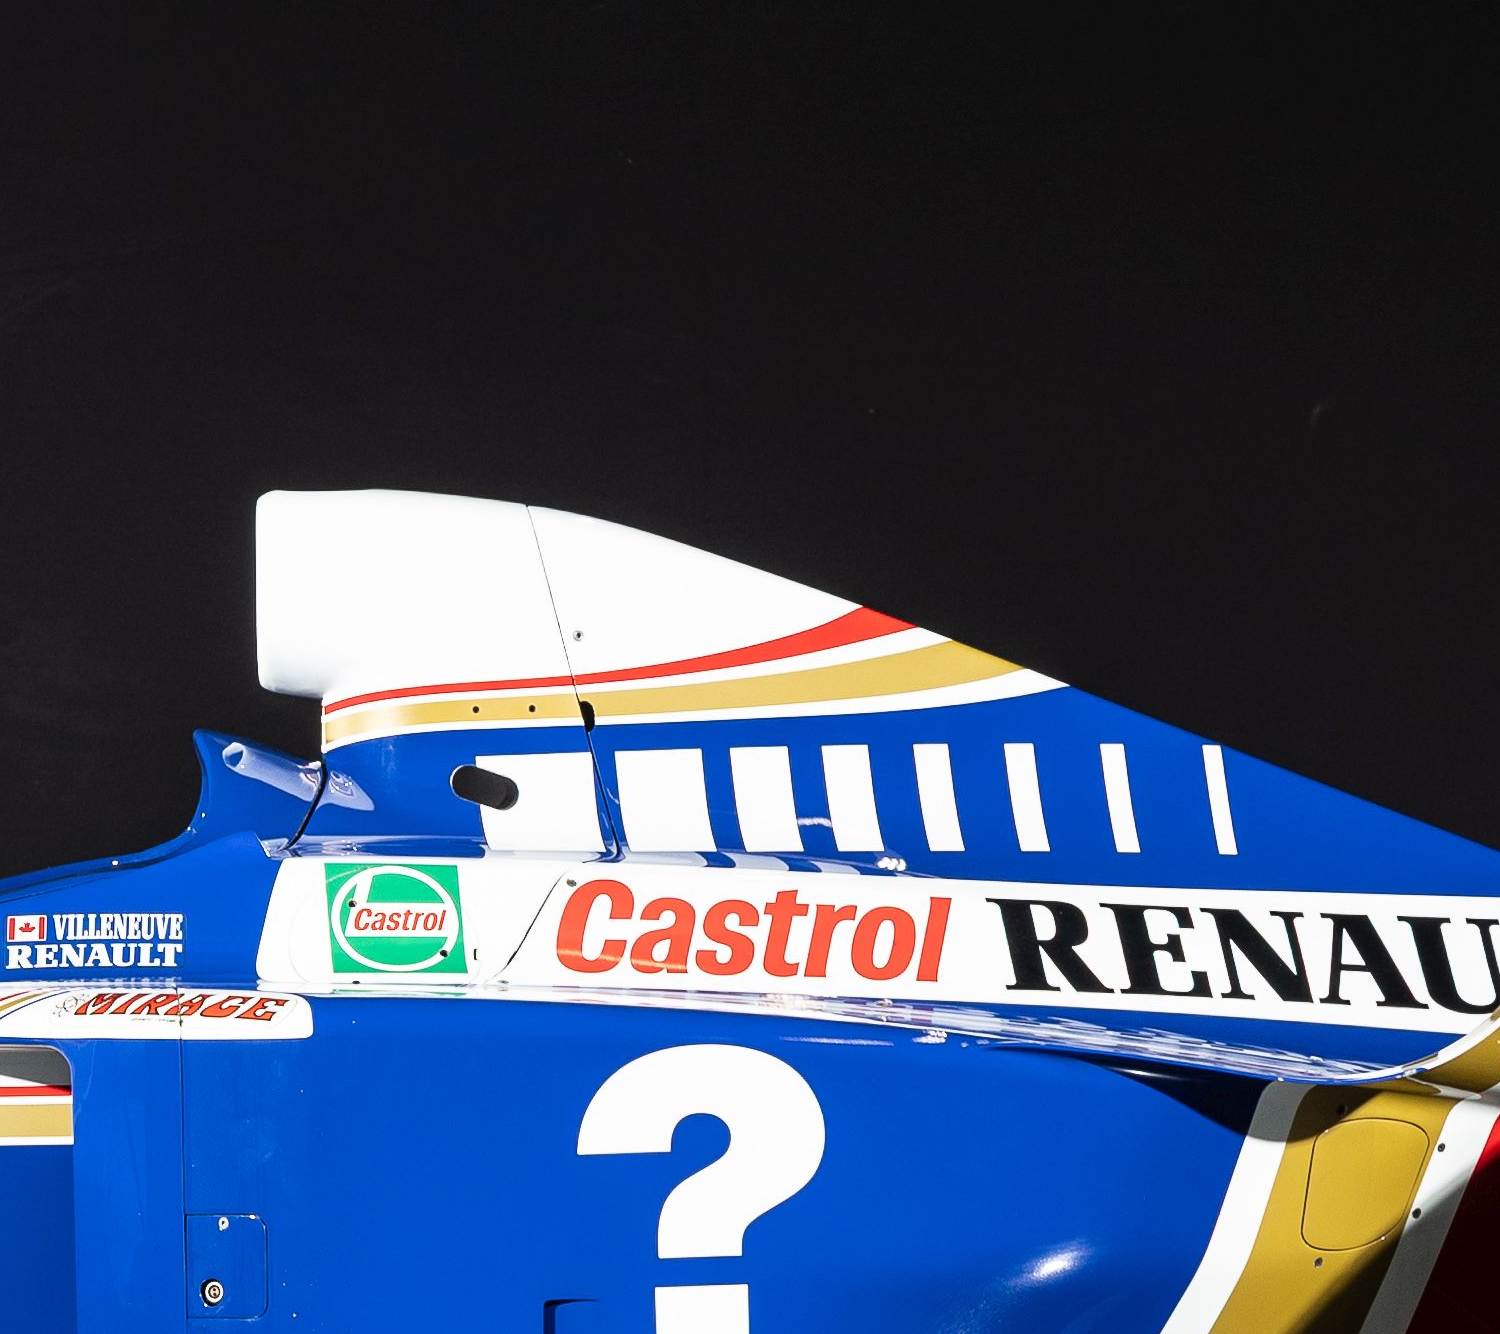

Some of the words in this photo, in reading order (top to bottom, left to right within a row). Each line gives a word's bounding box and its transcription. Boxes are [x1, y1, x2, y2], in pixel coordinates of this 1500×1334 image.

[53, 913, 184, 941] VILLENEUVE
[353, 907, 447, 933] Castrol
[556, 878, 951, 983] Castrol
[5, 943, 184, 969] RENAULT
[74, 993, 289, 1021] MIRAGE
